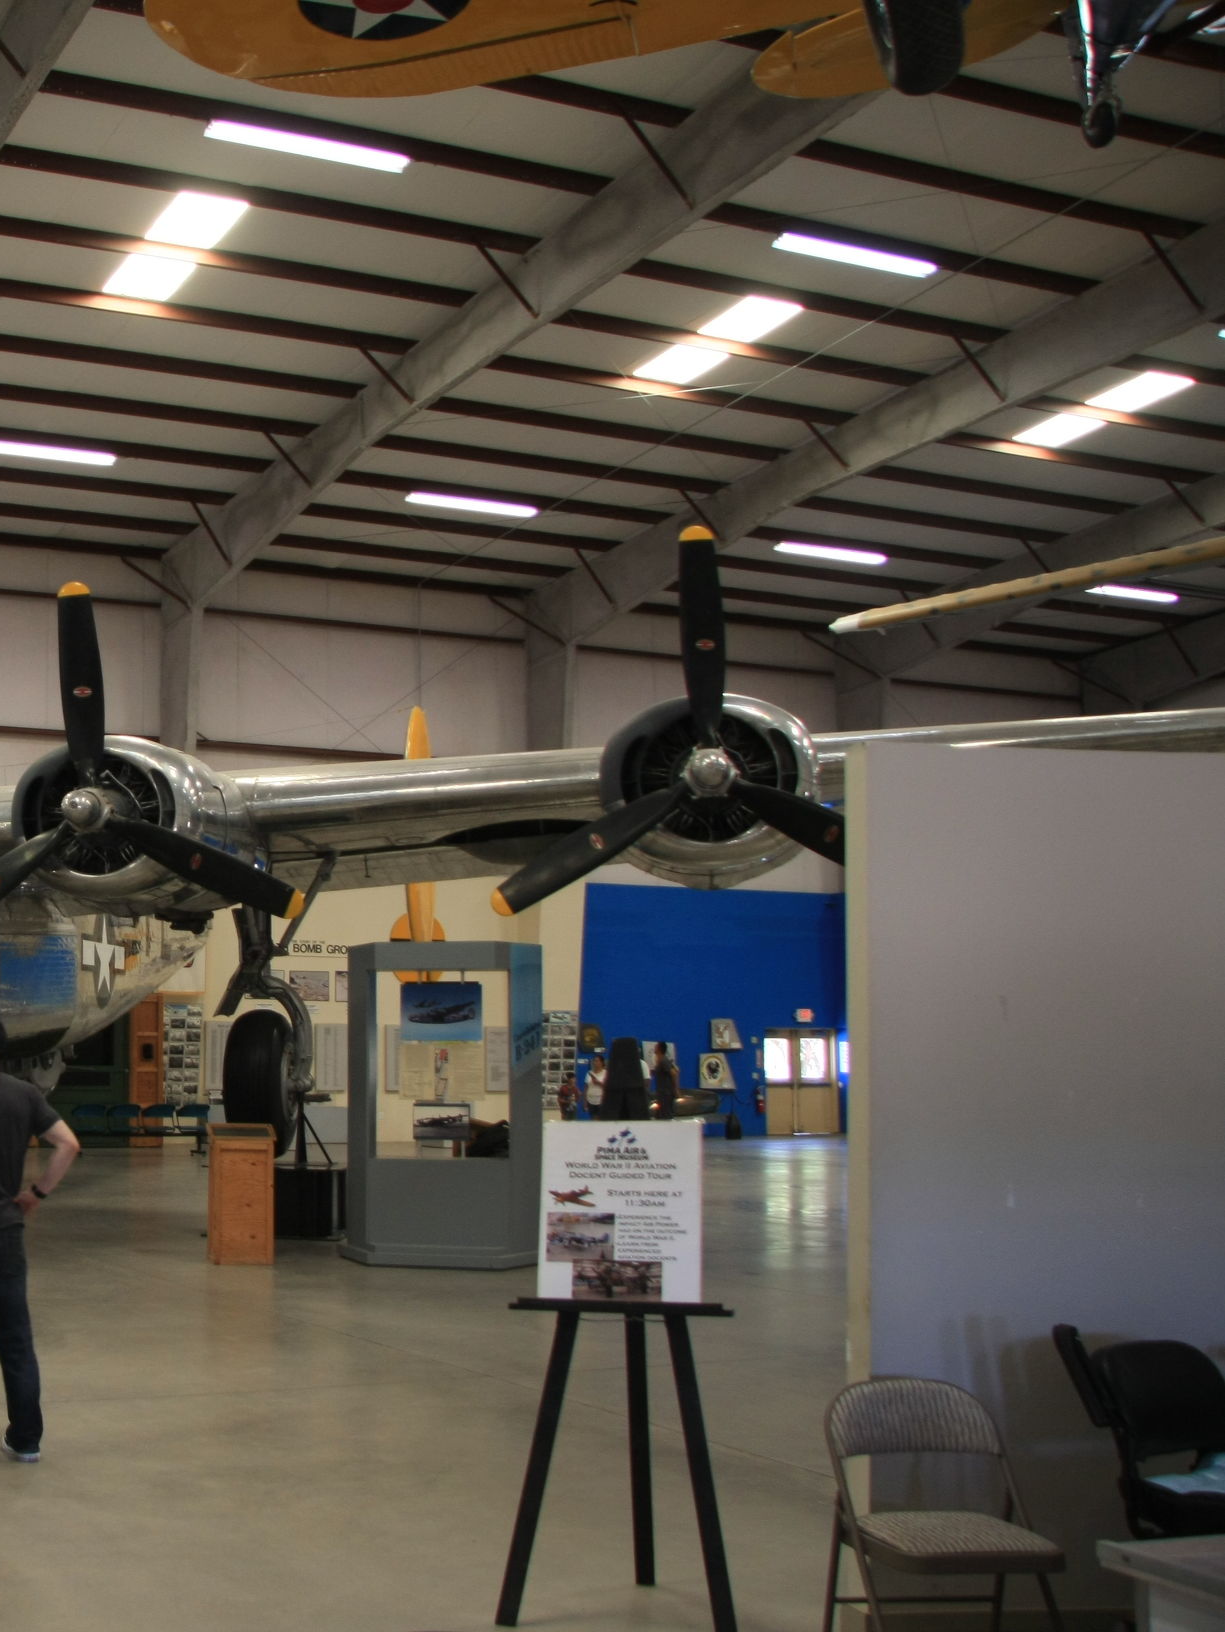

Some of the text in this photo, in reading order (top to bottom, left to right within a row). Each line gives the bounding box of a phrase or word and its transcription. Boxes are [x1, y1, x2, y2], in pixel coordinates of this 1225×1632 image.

[293, 943, 349, 955] BOMB GRO
[633, 1162, 677, 1170] AVIATION
